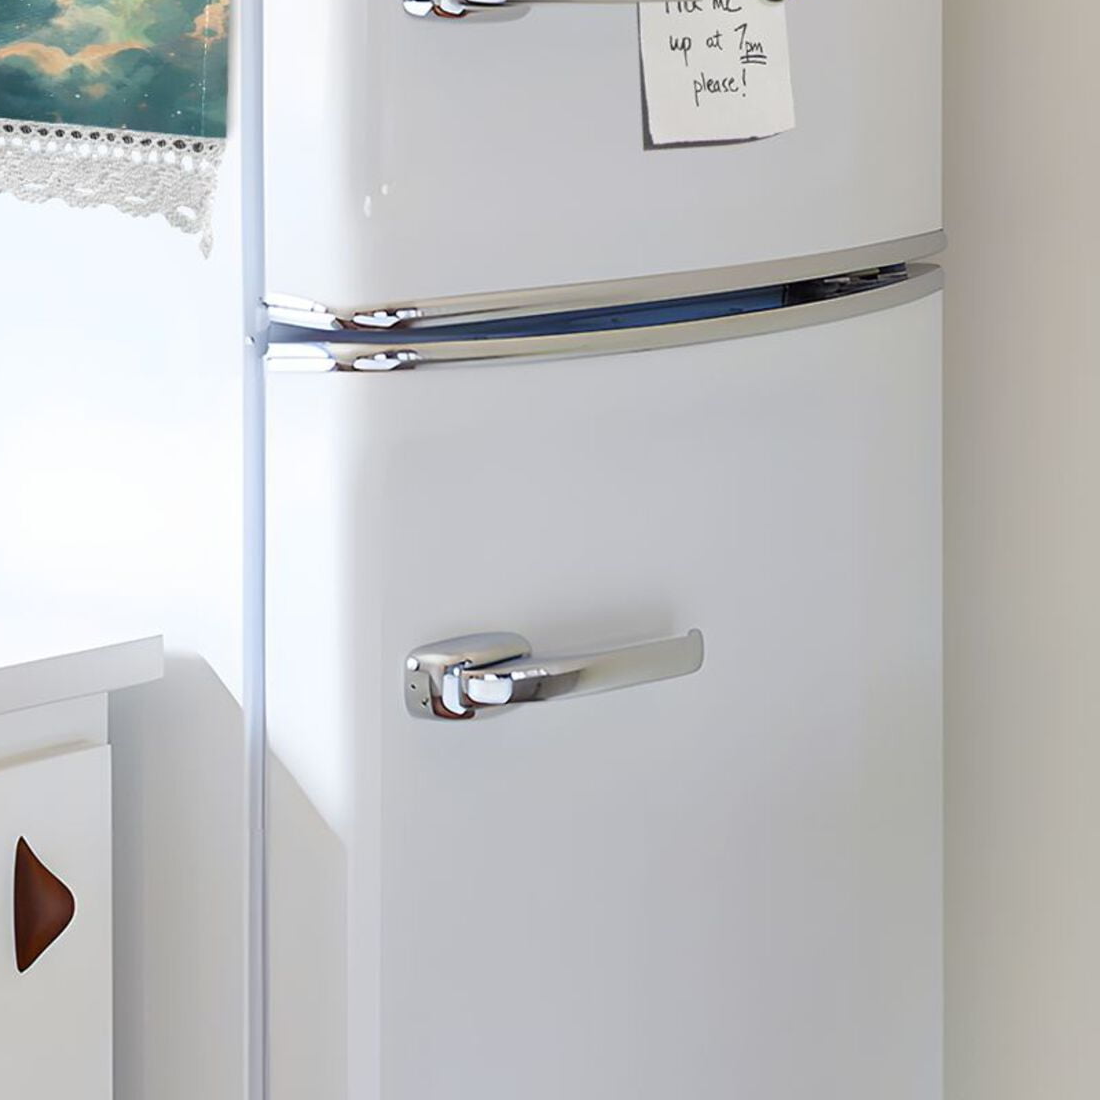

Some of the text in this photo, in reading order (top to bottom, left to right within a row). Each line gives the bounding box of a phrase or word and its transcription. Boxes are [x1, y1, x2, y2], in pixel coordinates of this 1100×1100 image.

[668, 34, 693, 67] up
[705, 29, 723, 51] at
[693, 67, 747, 107] please!
